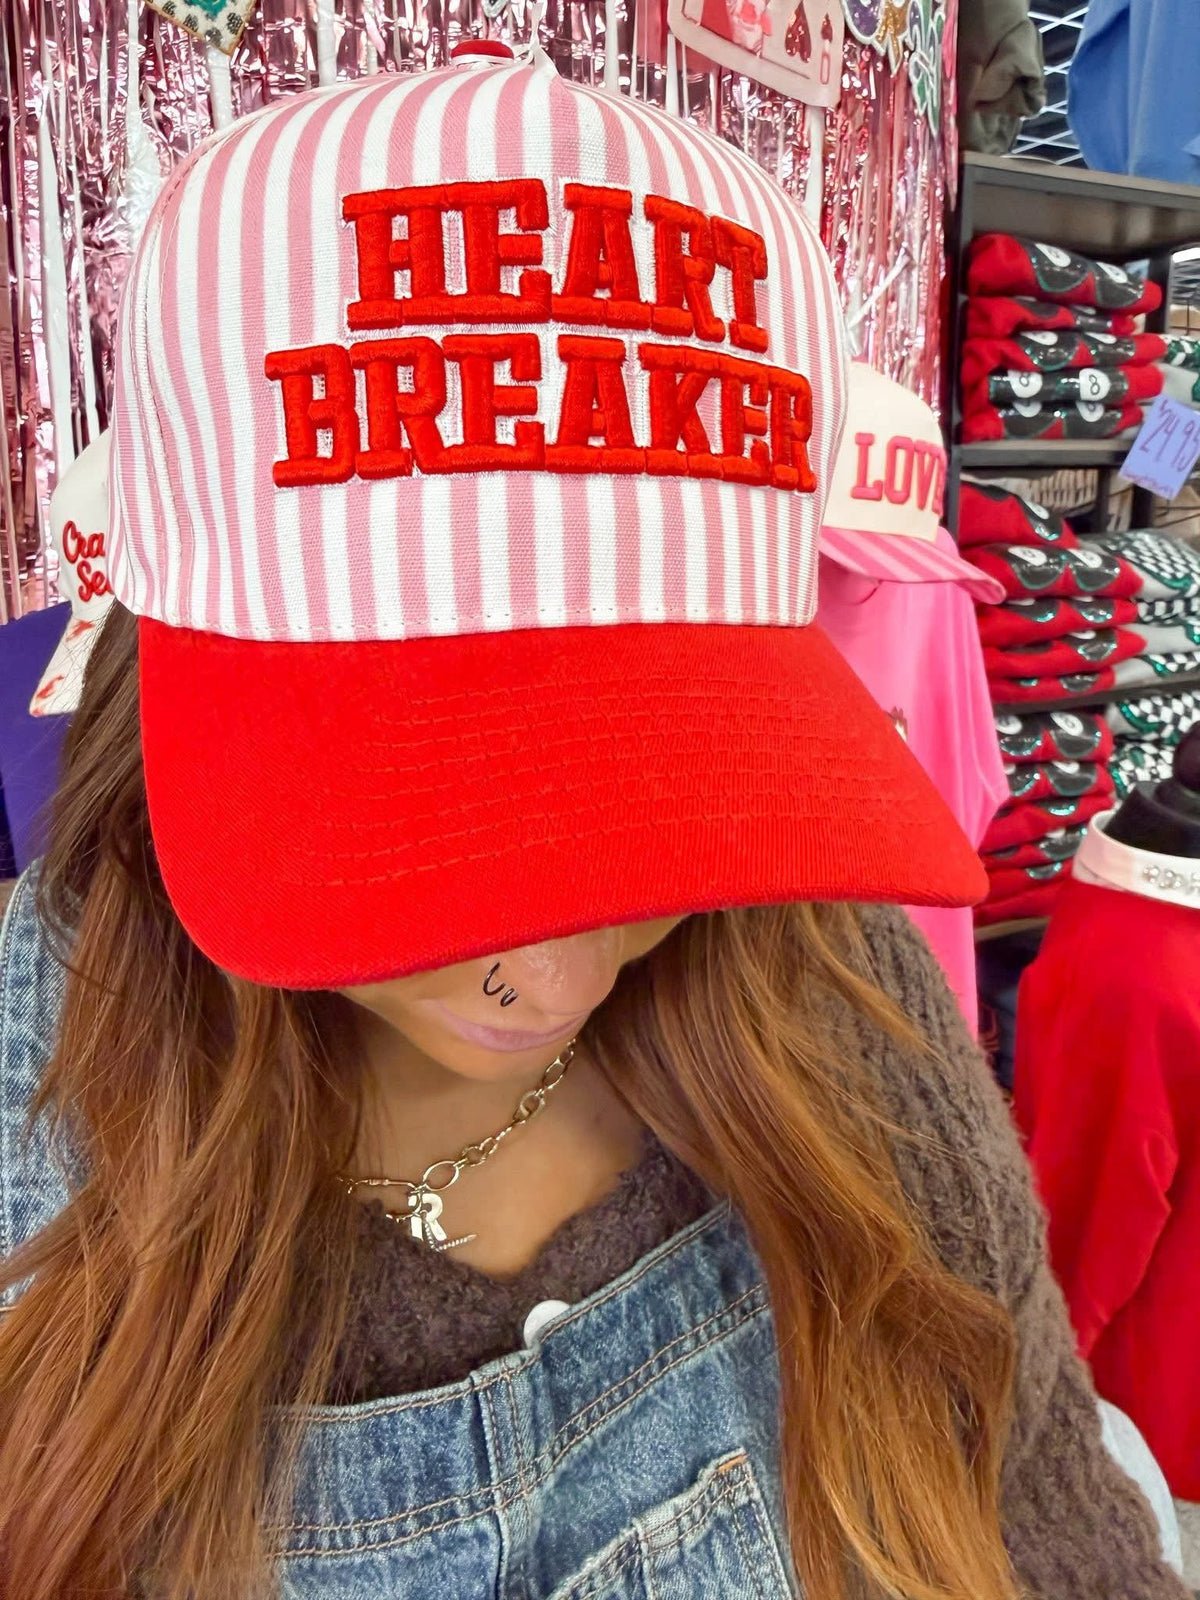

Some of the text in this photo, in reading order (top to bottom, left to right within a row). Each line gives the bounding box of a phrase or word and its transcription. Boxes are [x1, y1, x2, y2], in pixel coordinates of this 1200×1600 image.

[342, 179, 768, 353] HEART
[265, 333, 817, 493] BREAKER
[1089, 374, 1100, 395] 8
